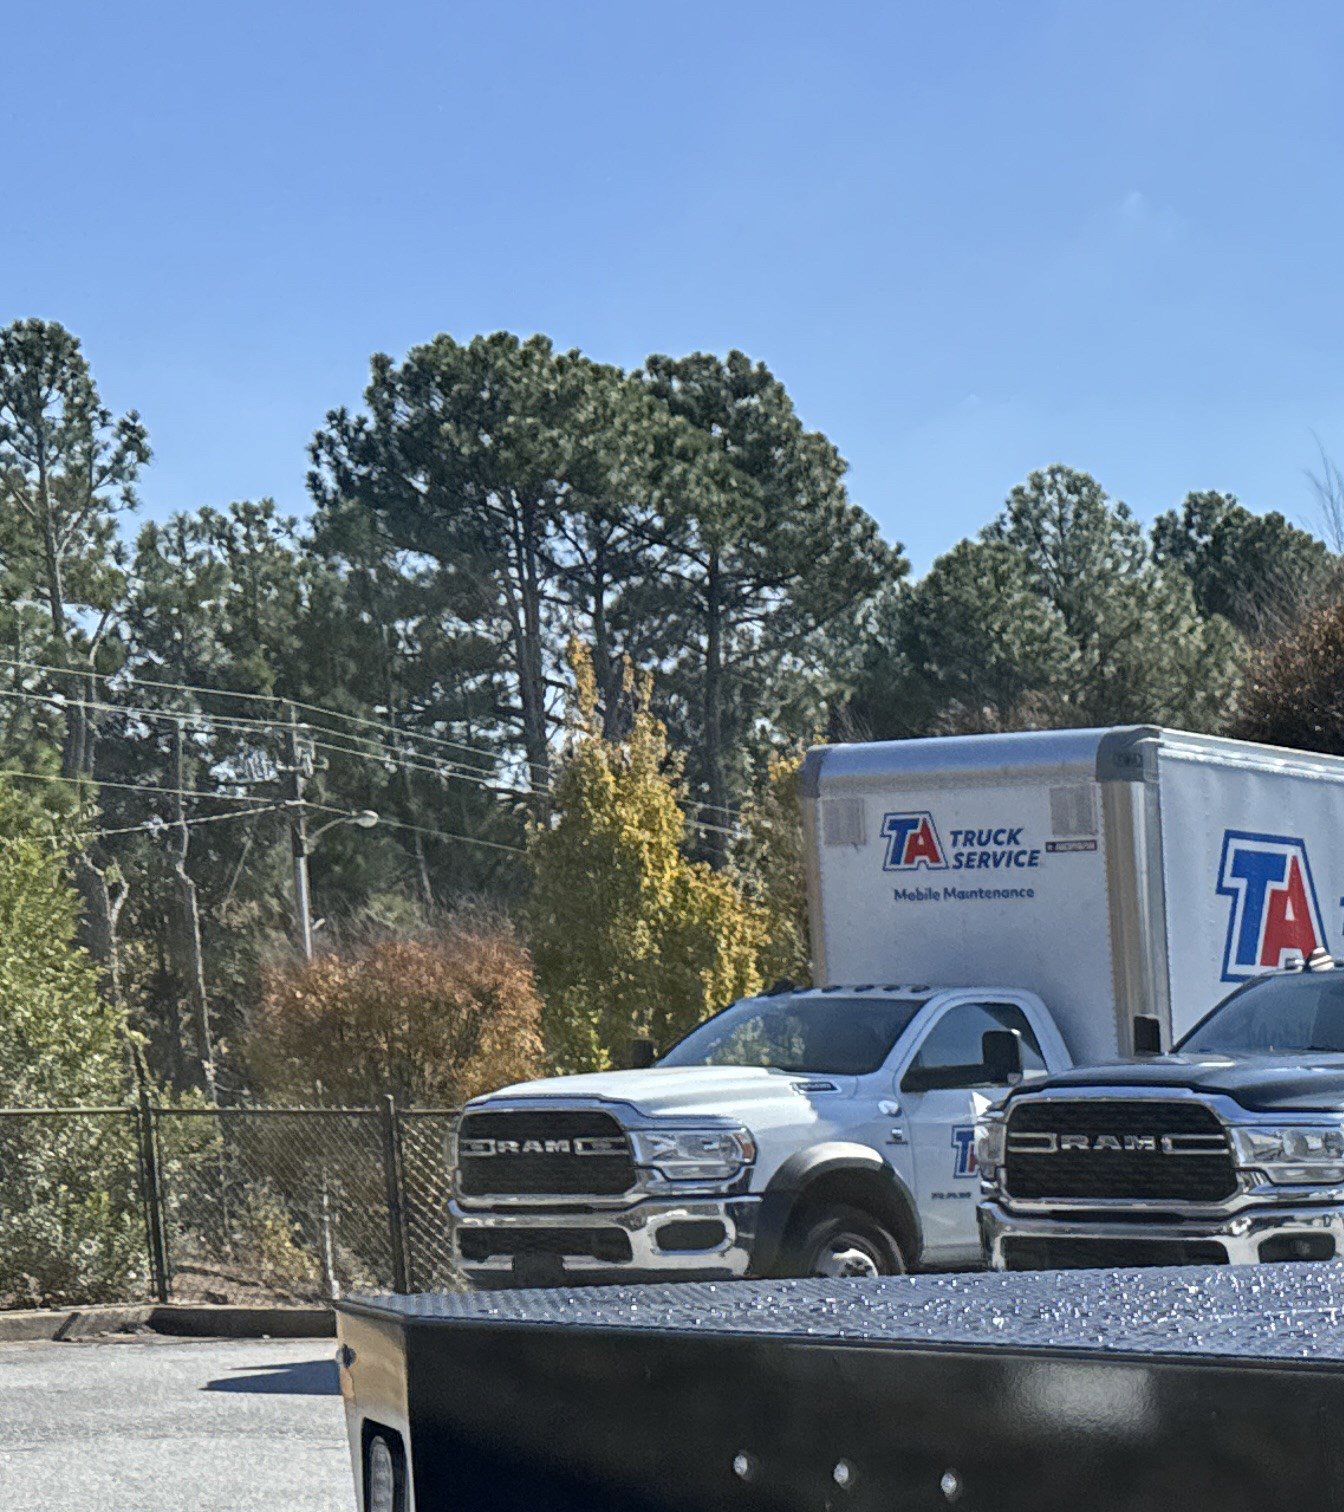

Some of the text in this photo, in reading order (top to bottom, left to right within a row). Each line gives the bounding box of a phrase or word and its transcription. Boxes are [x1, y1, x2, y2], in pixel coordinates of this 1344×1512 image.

[884, 814, 946, 868] TA
[949, 828, 1024, 848] TRUCK
[951, 849, 1041, 870] SERVICE
[894, 887, 1035, 901] Mobile Maintenance
[1222, 838, 1324, 974] TA
[496, 1139, 571, 1153] RAM
[1060, 1134, 1156, 1150] RAM
